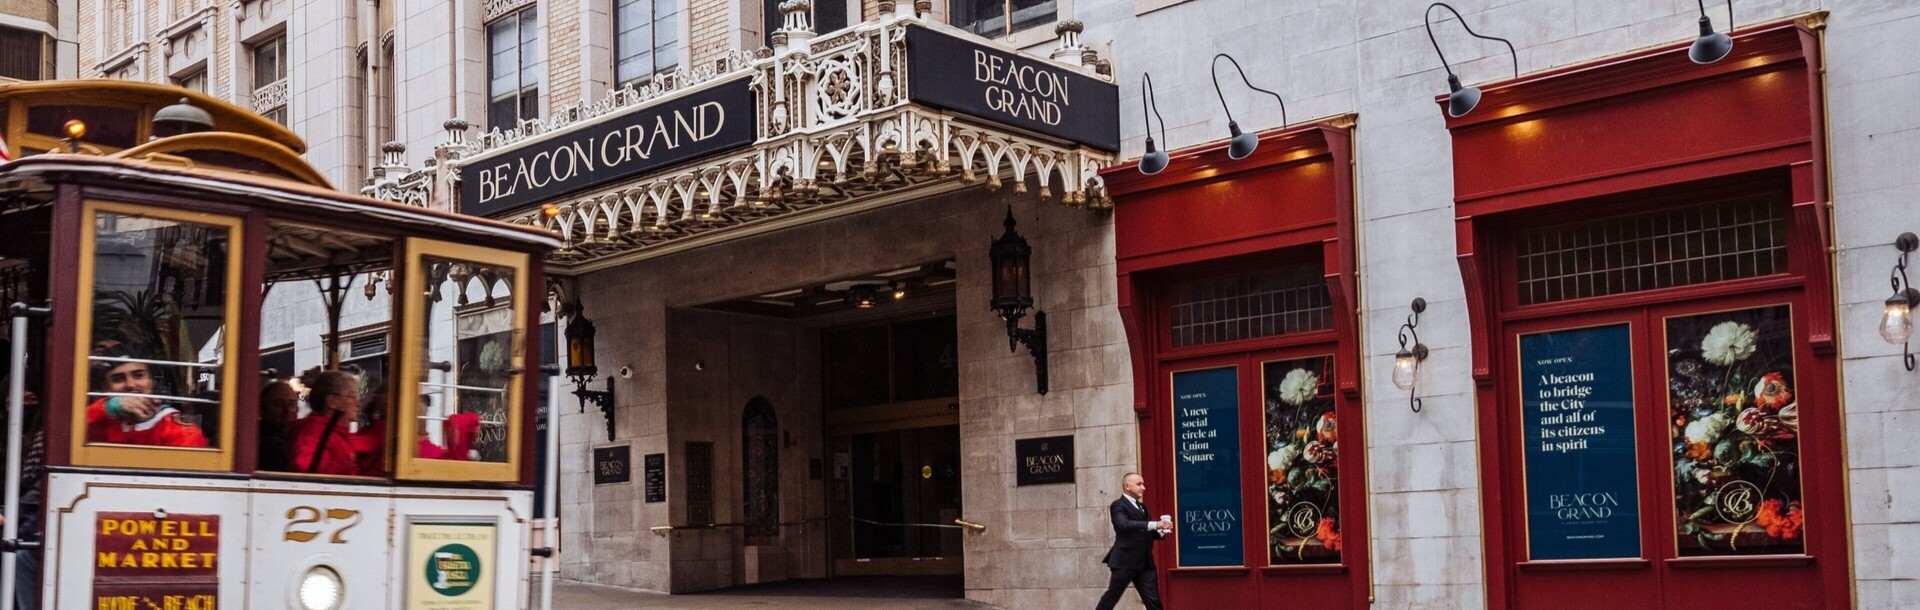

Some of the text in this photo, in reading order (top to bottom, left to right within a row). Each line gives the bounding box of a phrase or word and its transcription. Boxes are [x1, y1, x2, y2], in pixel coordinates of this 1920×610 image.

[974, 49, 1069, 106] BEACON
[985, 86, 1061, 126] GRAND
[478, 101, 725, 203] BEACON GRAND
[1538, 372, 1594, 386] A beacon
[1539, 385, 1592, 399] to bridge
[1181, 407, 1208, 417] A new
[1540, 399, 1585, 412] the City
[1181, 417, 1208, 428] social
[1540, 410, 1597, 425] and all of
[1182, 429, 1217, 440] circle at
[1541, 425, 1605, 439] its citizens
[1182, 441, 1209, 452] Union
[1541, 438, 1588, 453] in spirit
[1026, 454, 1064, 467] BEACON
[1182, 452, 1215, 465] Square
[1029, 464, 1061, 474] GRAND
[1550, 491, 1618, 509] BEACON
[1185, 508, 1236, 523] BEACON
[1557, 506, 1611, 520] GRAND
[102, 519, 216, 537] POWELL
[282, 506, 362, 543] 27
[1191, 521, 1231, 533] GRAND
[131, 538, 190, 551] AND
[98, 552, 216, 568] MARKET
